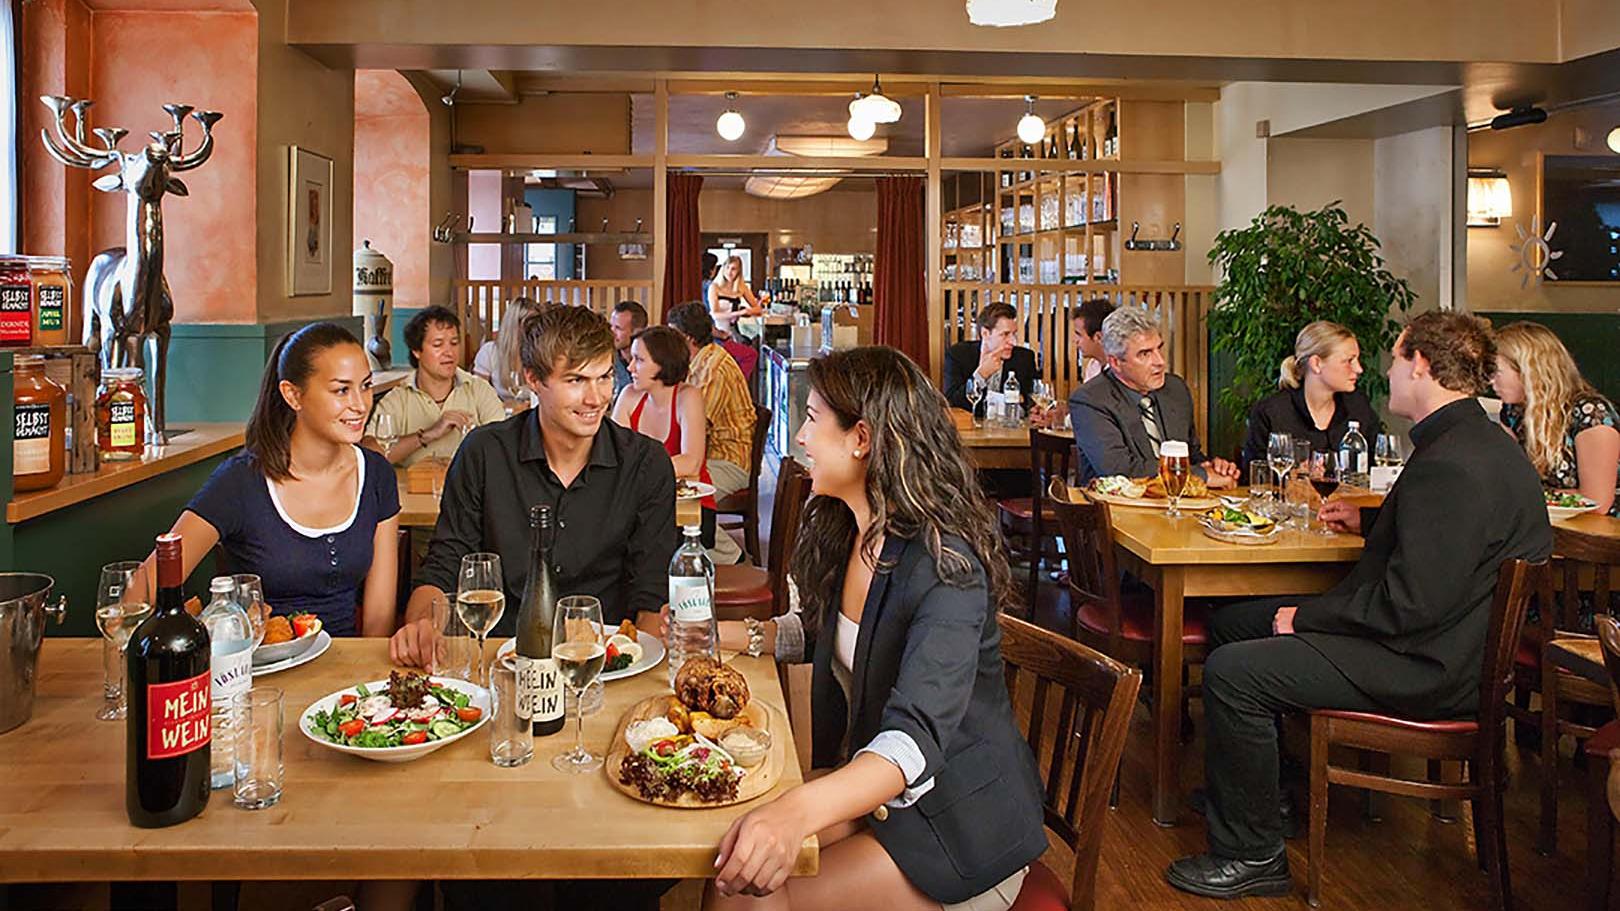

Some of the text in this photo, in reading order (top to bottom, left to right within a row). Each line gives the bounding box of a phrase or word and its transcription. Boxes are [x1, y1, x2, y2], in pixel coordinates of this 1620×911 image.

[2, 290, 29, 302] SELBST
[40, 290, 62, 302] SELBST
[16, 412, 49, 426] SELBST
[164, 685, 209, 719] MEIN
[161, 714, 210, 750] WEIN
